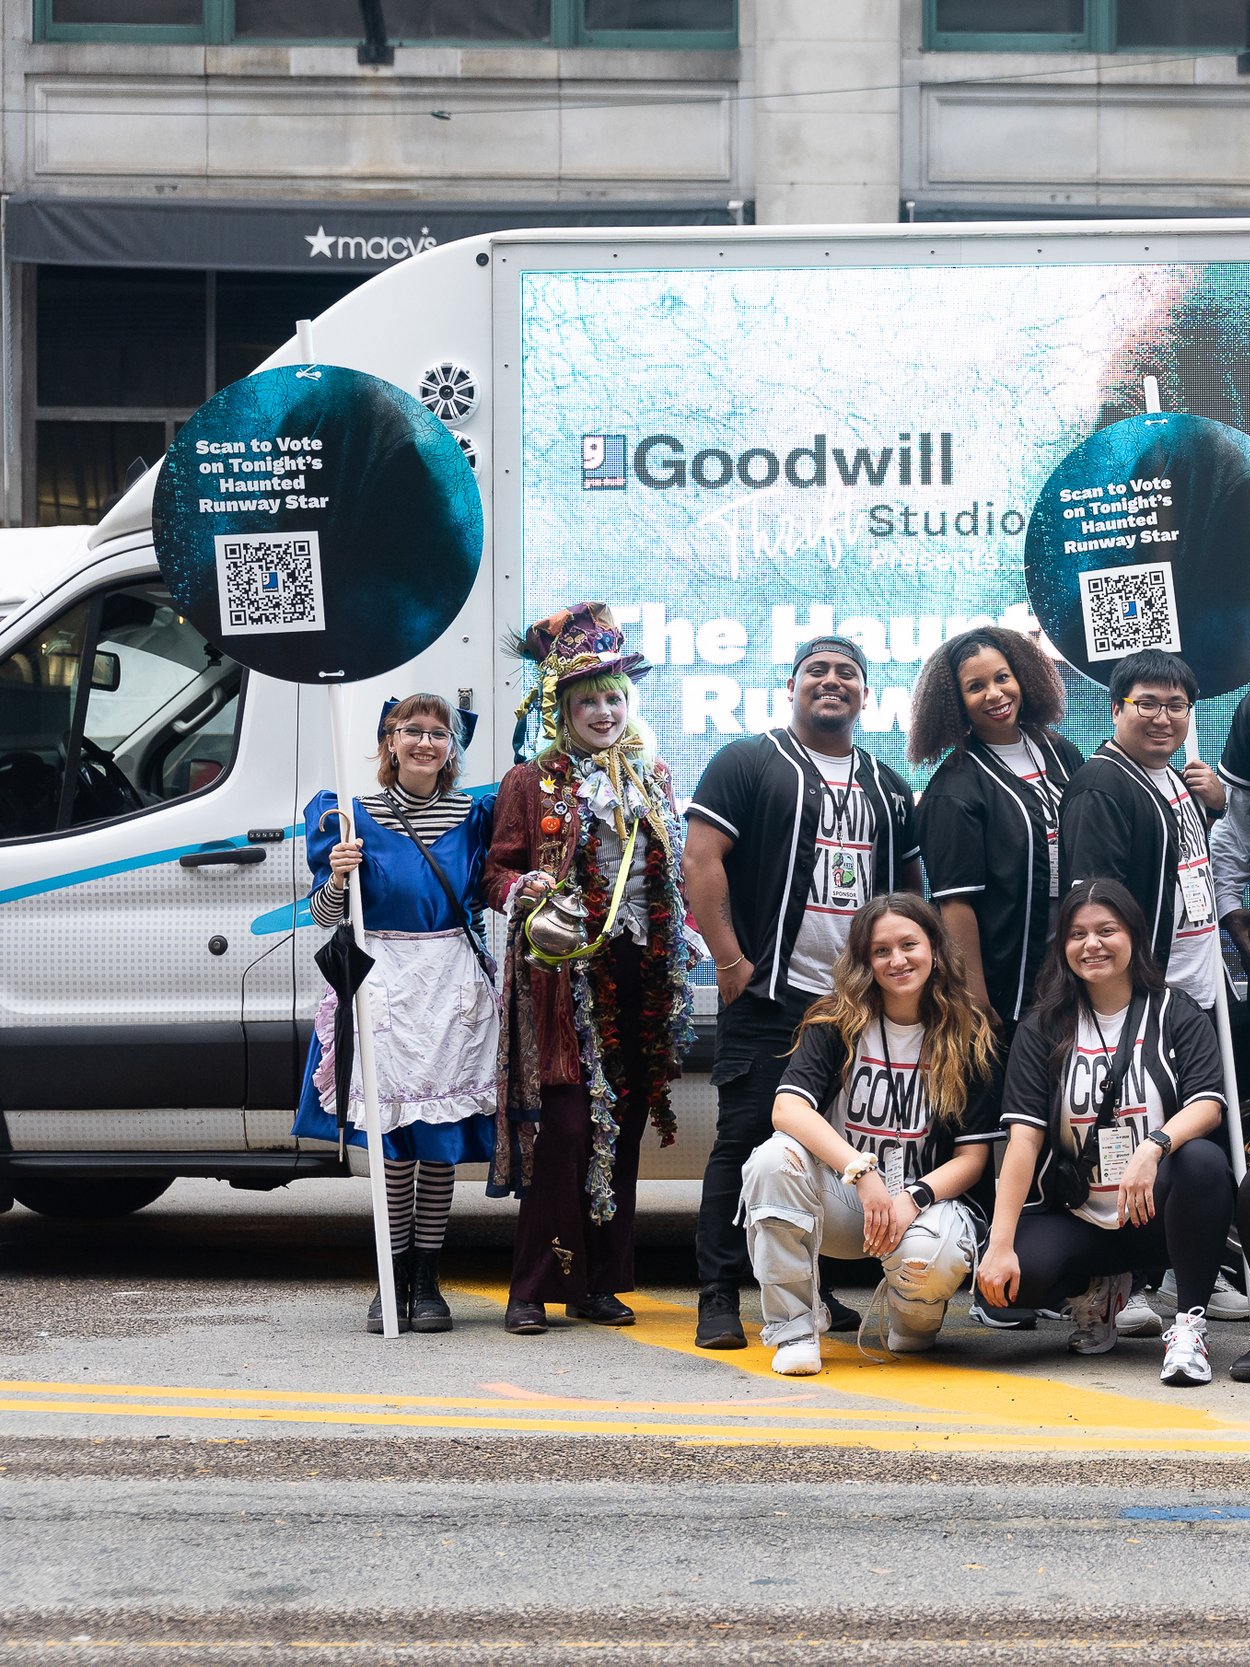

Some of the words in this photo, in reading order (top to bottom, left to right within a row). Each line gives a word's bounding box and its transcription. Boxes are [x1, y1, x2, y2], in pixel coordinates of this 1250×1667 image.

[195, 440, 246, 455] Scan
[250, 438, 273, 453] to
[275, 436, 323, 452] Vote
[199, 462, 225, 474] on
[228, 455, 323, 475] Tonight's
[634, 433, 953, 490] Goodwill
[219, 474, 306, 493] Haunted
[1059, 487, 1104, 503] Scan
[1106, 482, 1127, 496] to
[1129, 477, 1172, 493] Vote
[198, 498, 281, 514] Runway
[285, 494, 329, 509] Star
[1063, 506, 1086, 519] on
[1088, 493, 1173, 516] Tonight's
[869, 501, 1025, 537] Studio
[1081, 511, 1158, 535] Haunted
[1064, 534, 1137, 554] Runway
[1139, 529, 1180, 544] Star
[832, 890, 857, 898] SPONSOR
